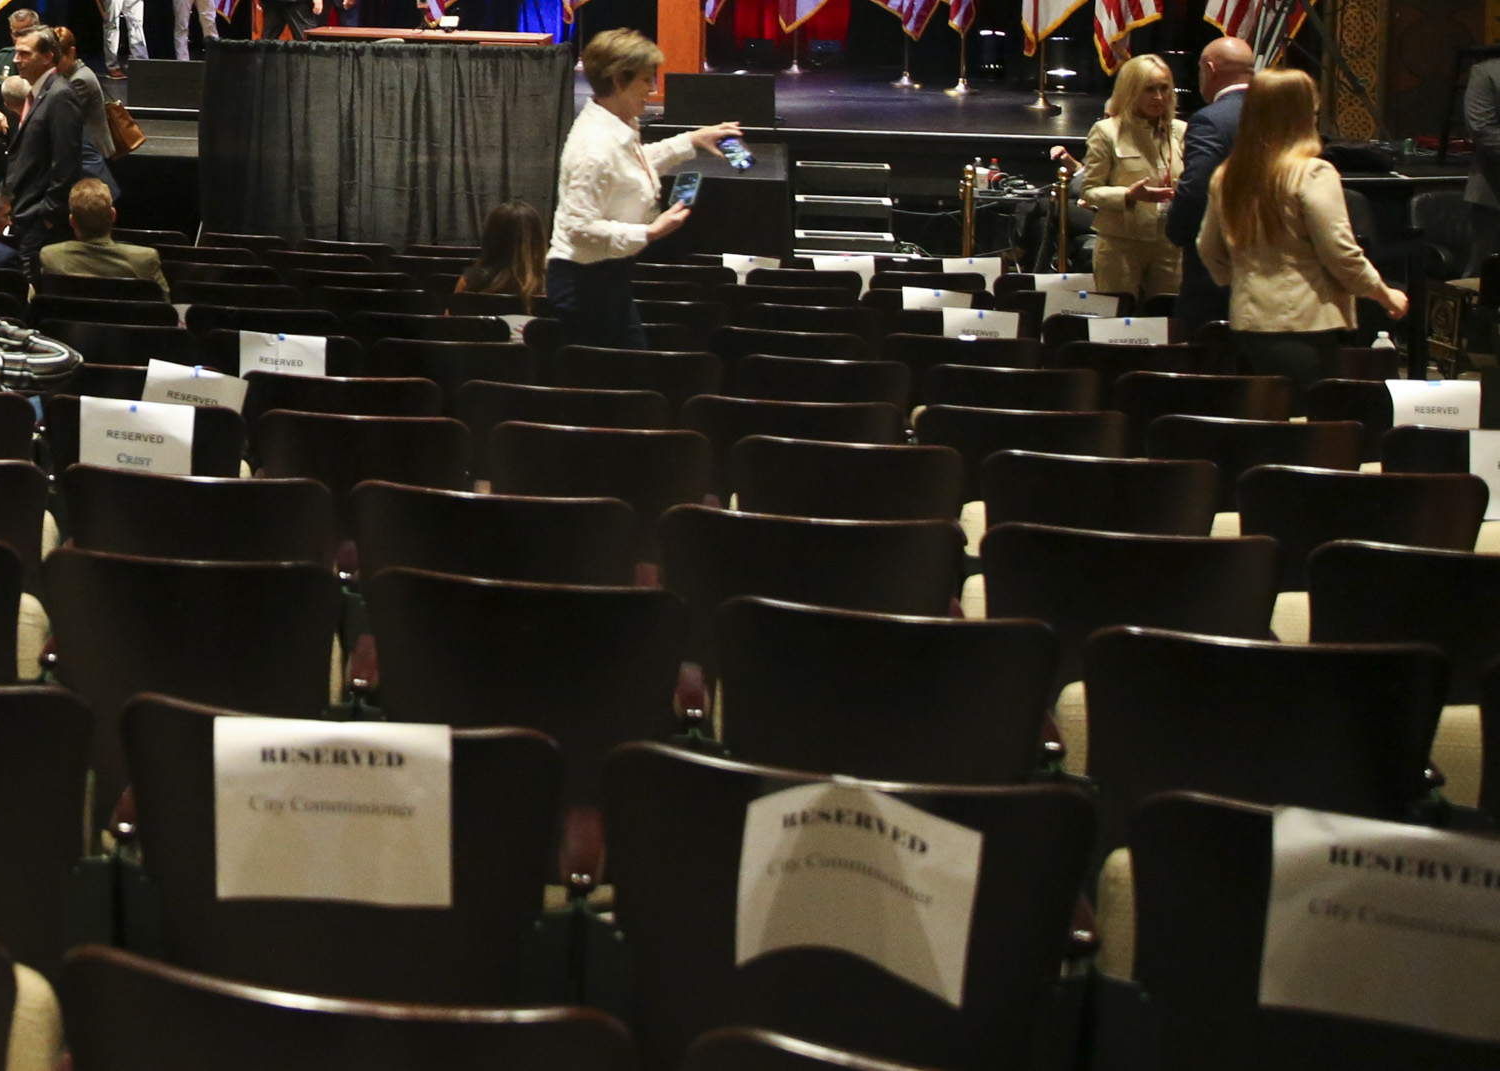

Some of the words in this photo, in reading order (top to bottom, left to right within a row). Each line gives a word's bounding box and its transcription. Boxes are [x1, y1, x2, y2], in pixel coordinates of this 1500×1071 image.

[258, 355, 304, 367] RESERVED
[166, 389, 219, 406] RESERVED
[1414, 405, 1460, 415] RESERVED
[106, 429, 165, 445] RESERVED
[260, 747, 405, 768] RESERVED
[782, 808, 928, 855] RESERVED
